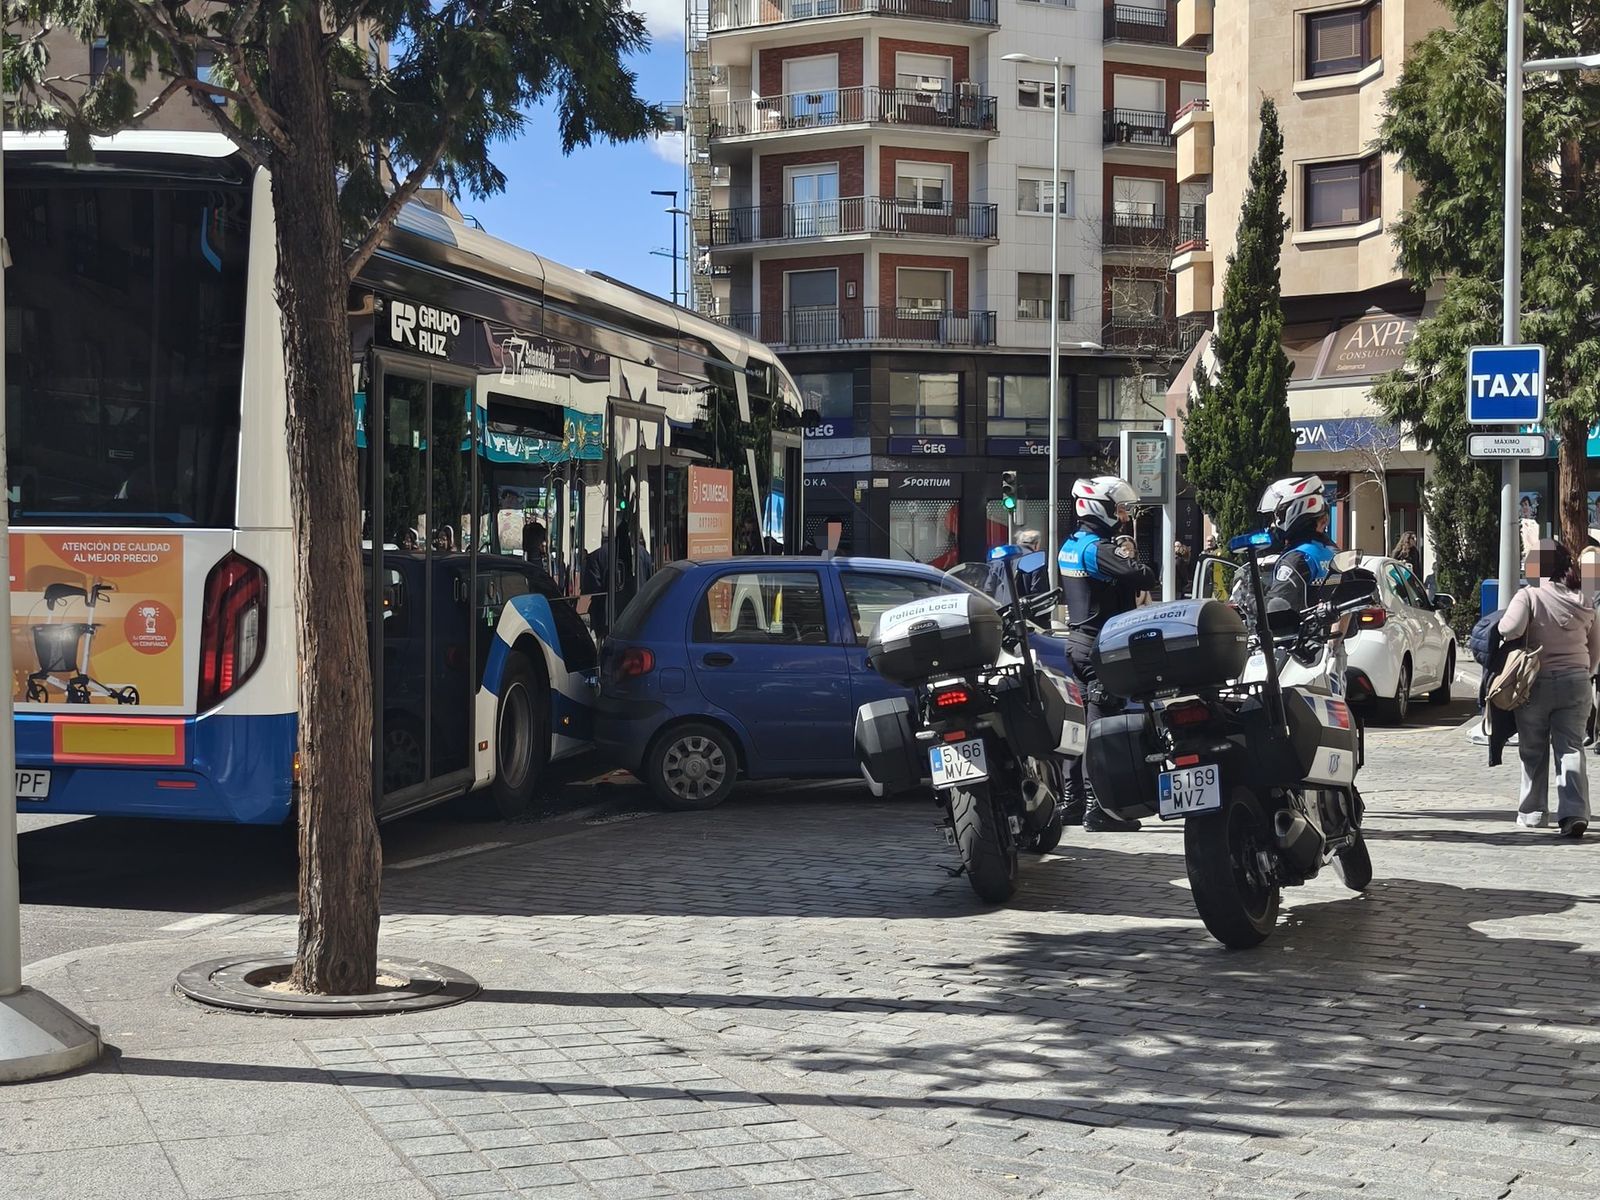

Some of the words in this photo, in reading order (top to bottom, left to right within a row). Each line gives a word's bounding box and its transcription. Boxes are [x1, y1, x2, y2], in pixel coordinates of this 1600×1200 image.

[419, 305, 460, 336] GRUPO
[419, 329, 447, 356] RUIZ
[1340, 348, 1404, 360] CONSULTING
[1472, 373, 1539, 398] TAXI
[1291, 424, 1327, 445] BVA
[923, 443, 946, 454] CEG
[1030, 445, 1051, 455] CEG
[898, 476, 951, 488] SPORTIUM
[62, 541, 110, 551] ATENCIÓN
[113, 543, 125, 551] DE
[128, 543, 170, 551] CALIDAD
[74, 554, 86, 562] AL
[88, 554, 120, 563] MEJOR
[123, 554, 158, 562] PRECIO
[890, 607, 925, 623] Policía
[929, 602, 958, 612] Local
[1153, 609, 1187, 620] Local
[942, 743, 981, 763] 5166
[945, 760, 974, 779] MVZ
[1172, 769, 1215, 790] 5169
[1173, 789, 1205, 810] MVZ
